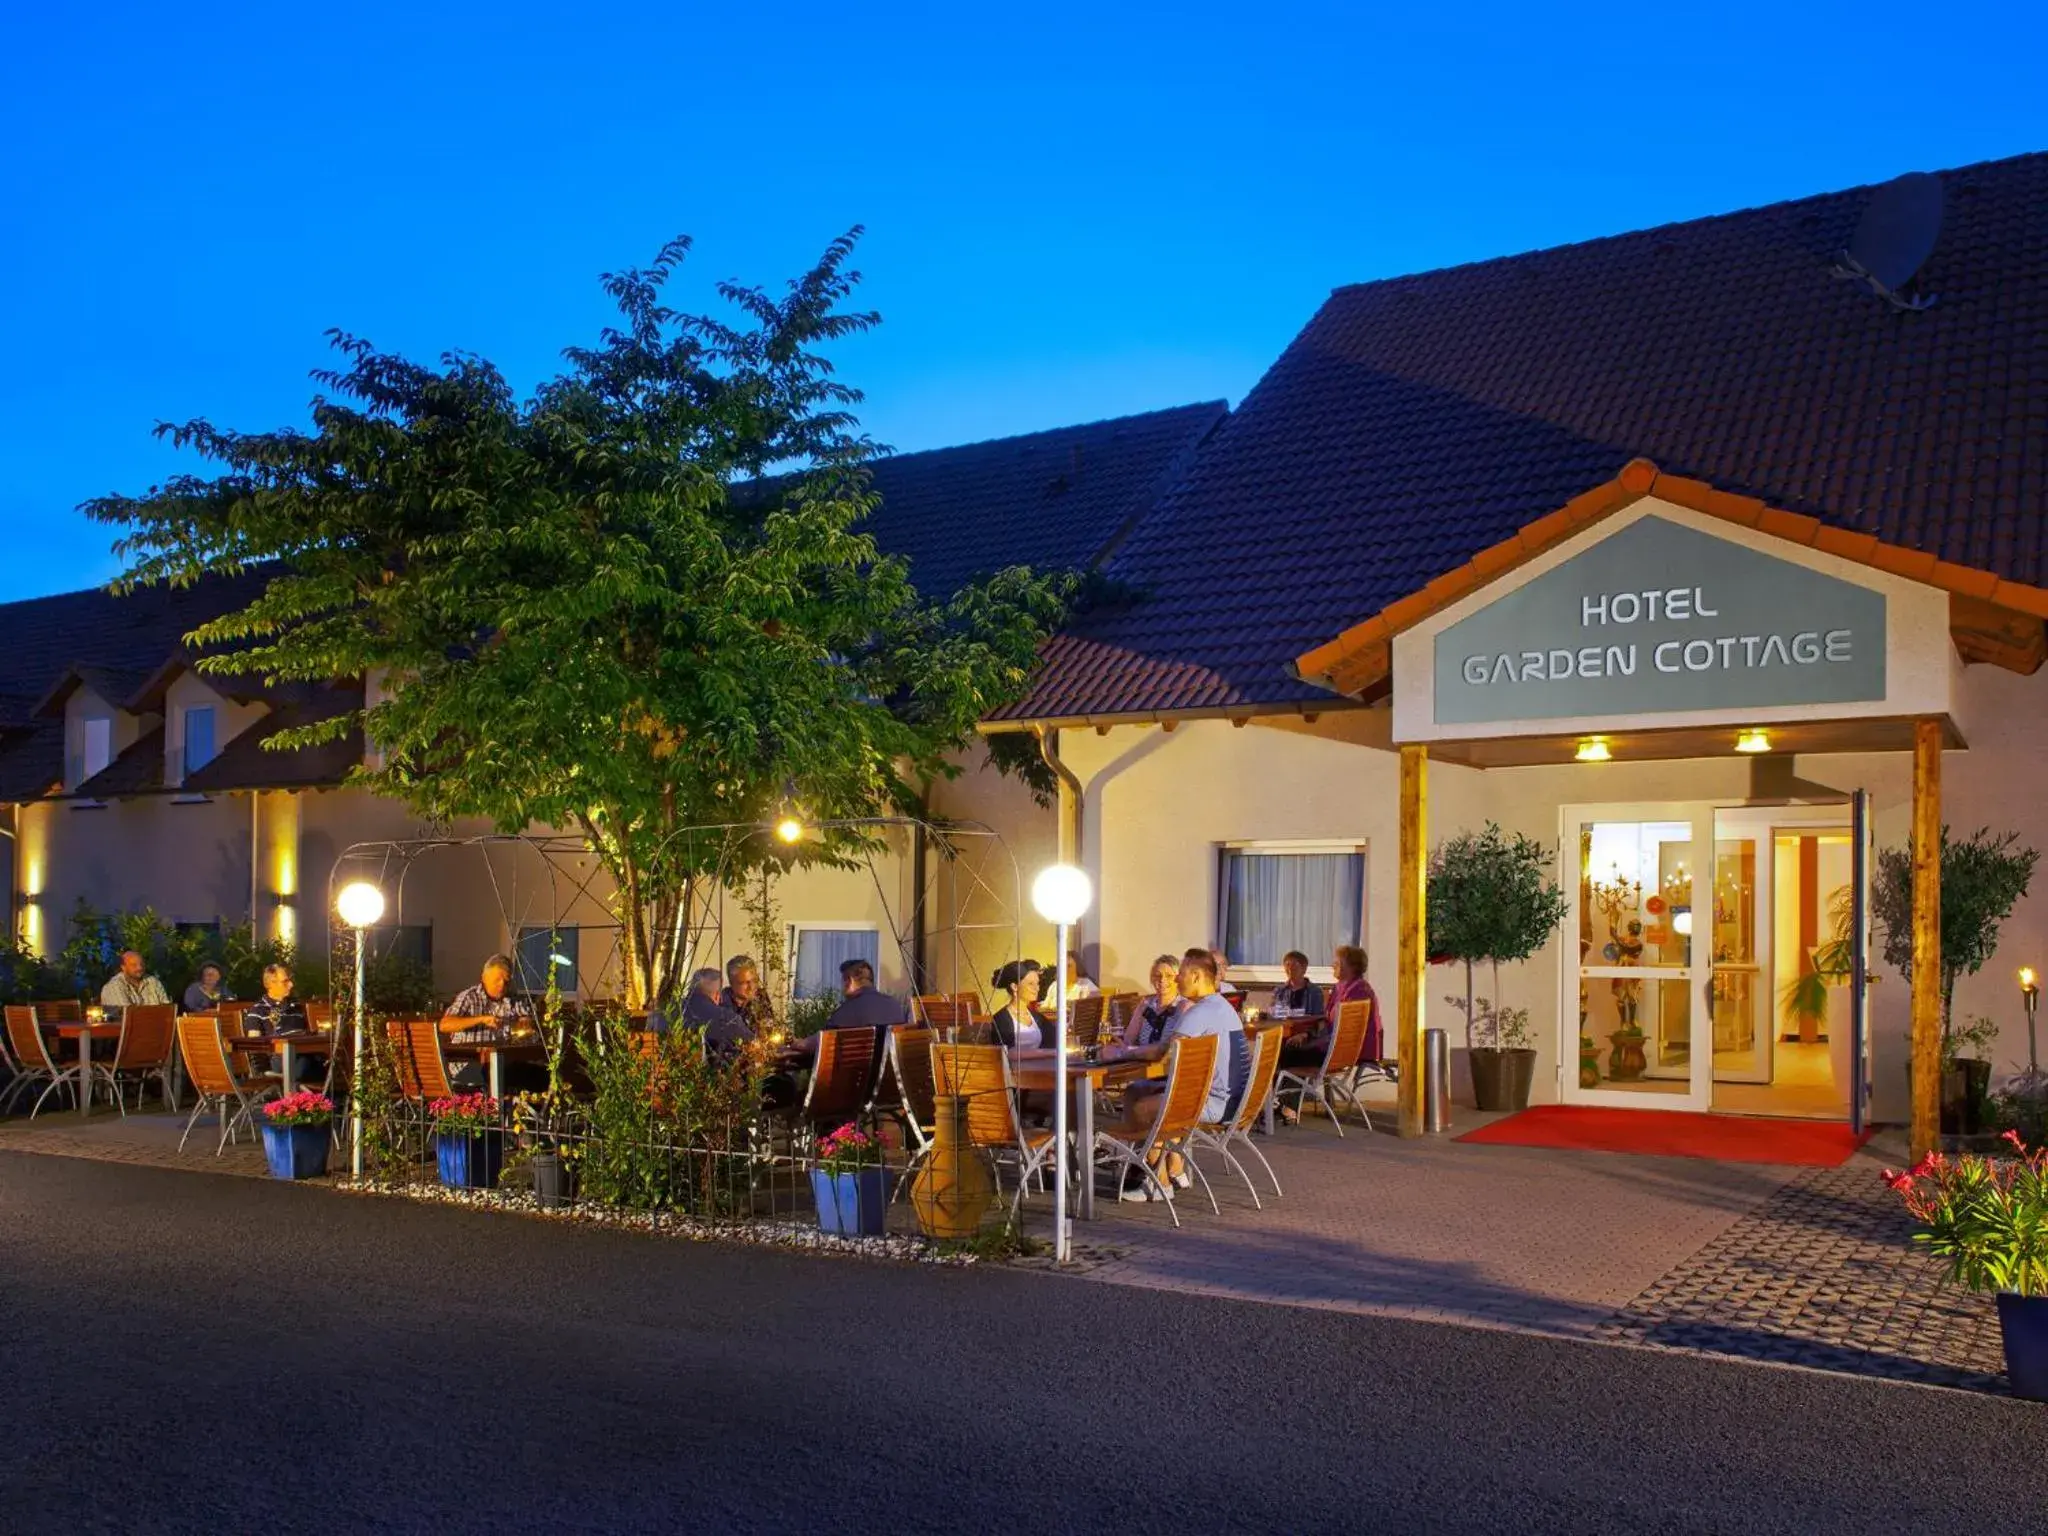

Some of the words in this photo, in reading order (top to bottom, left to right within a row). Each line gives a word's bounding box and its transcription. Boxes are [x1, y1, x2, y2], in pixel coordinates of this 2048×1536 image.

[1581, 588, 1718, 626] HOTEL
[1463, 645, 1637, 685] GARDEN
[1653, 629, 1853, 673] COTTAGE
